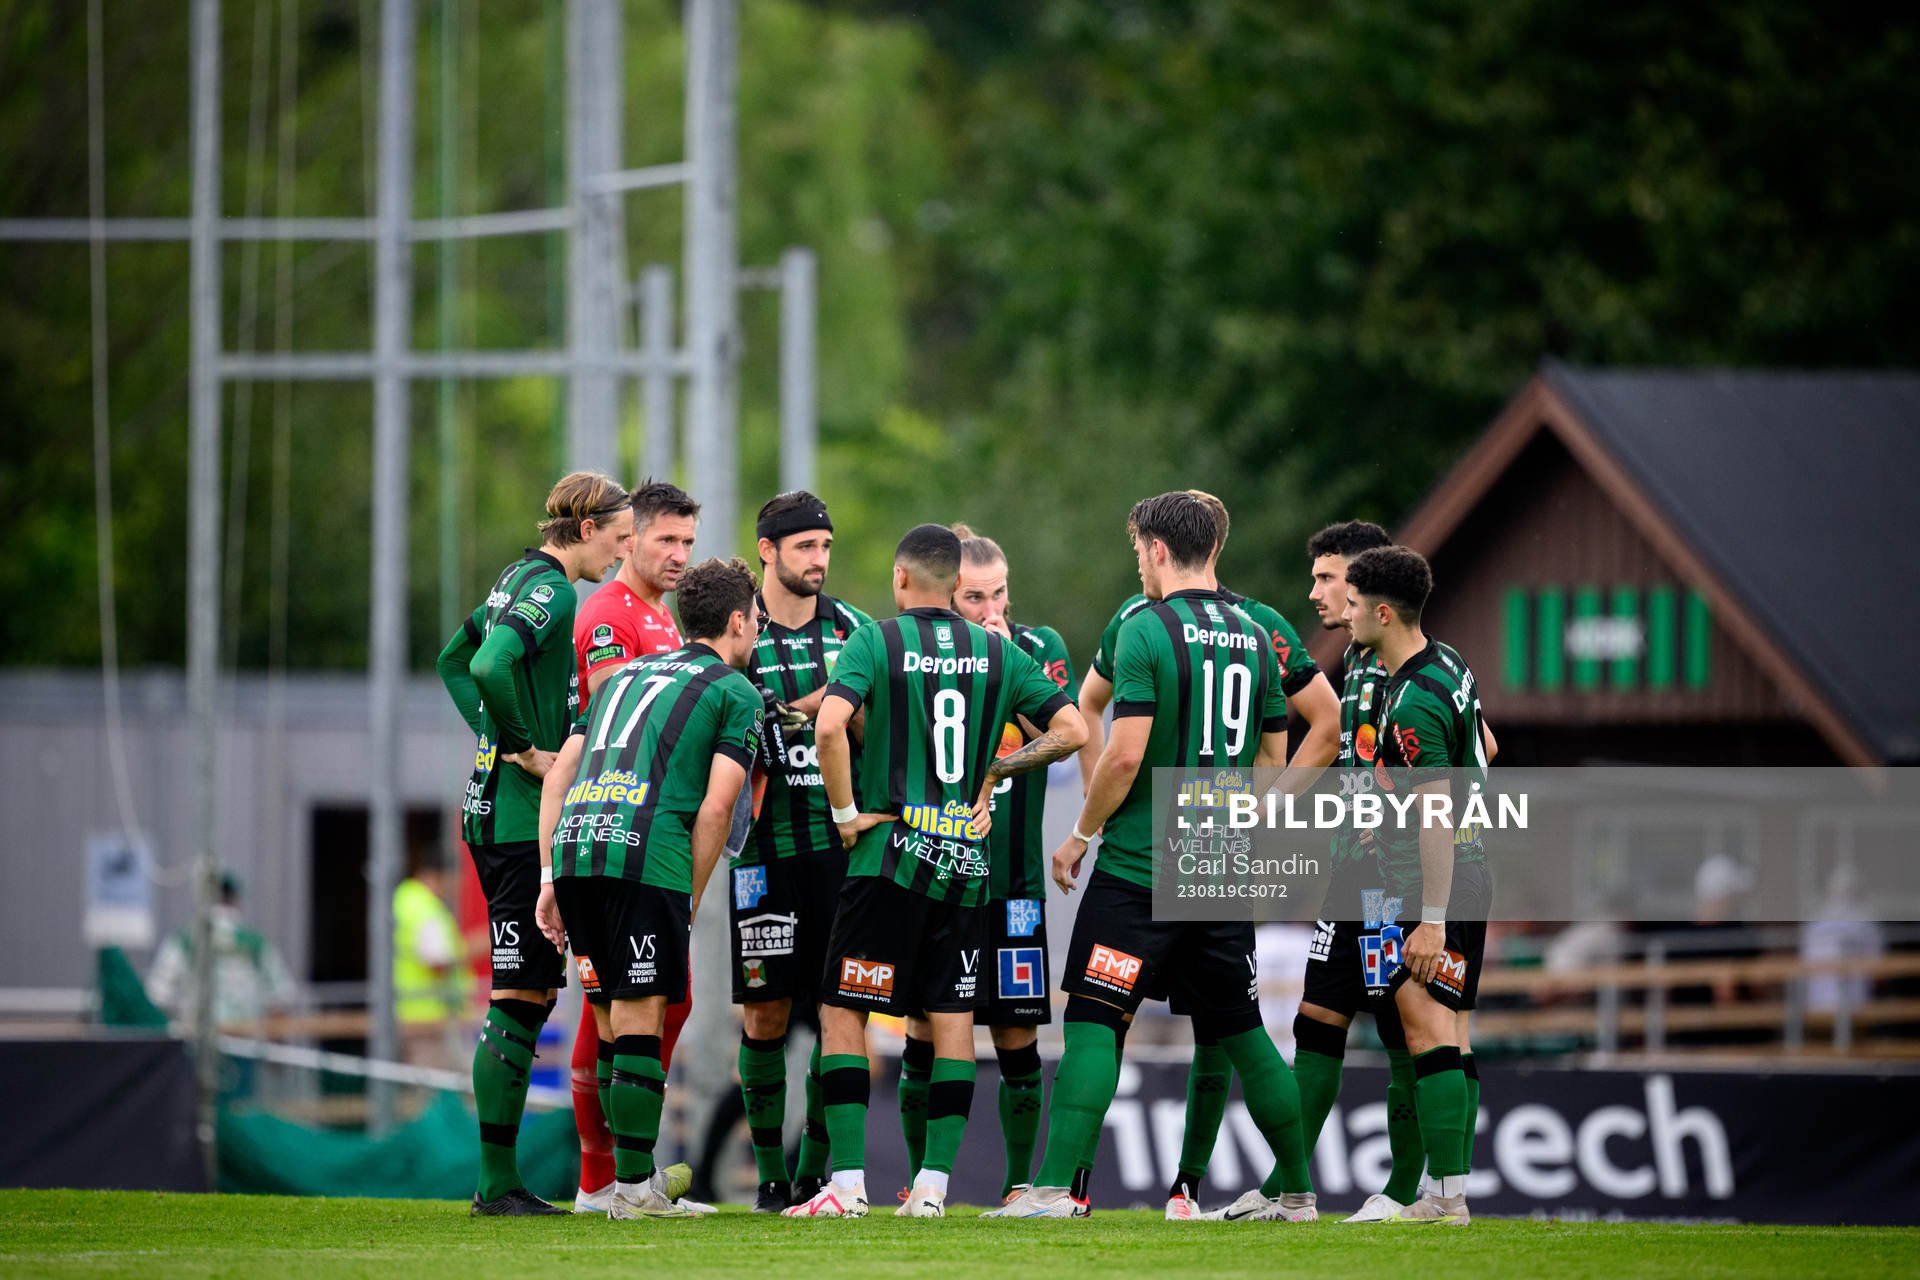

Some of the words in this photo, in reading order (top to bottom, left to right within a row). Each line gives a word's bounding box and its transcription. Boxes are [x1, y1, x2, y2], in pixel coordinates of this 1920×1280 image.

[1184, 624, 1257, 651] Derome
[589, 646, 621, 660] UNIBET
[904, 652, 989, 674] Derome
[592, 675, 677, 752] 17
[1200, 660, 1251, 757] 19
[933, 689, 965, 783] 8
[565, 781, 648, 806] ullared
[559, 814, 623, 829] NORDIC
[492, 921, 520, 946] VS
[630, 934, 657, 960] VS
[844, 960, 893, 987] FMP
[1091, 948, 1139, 979] FMP
